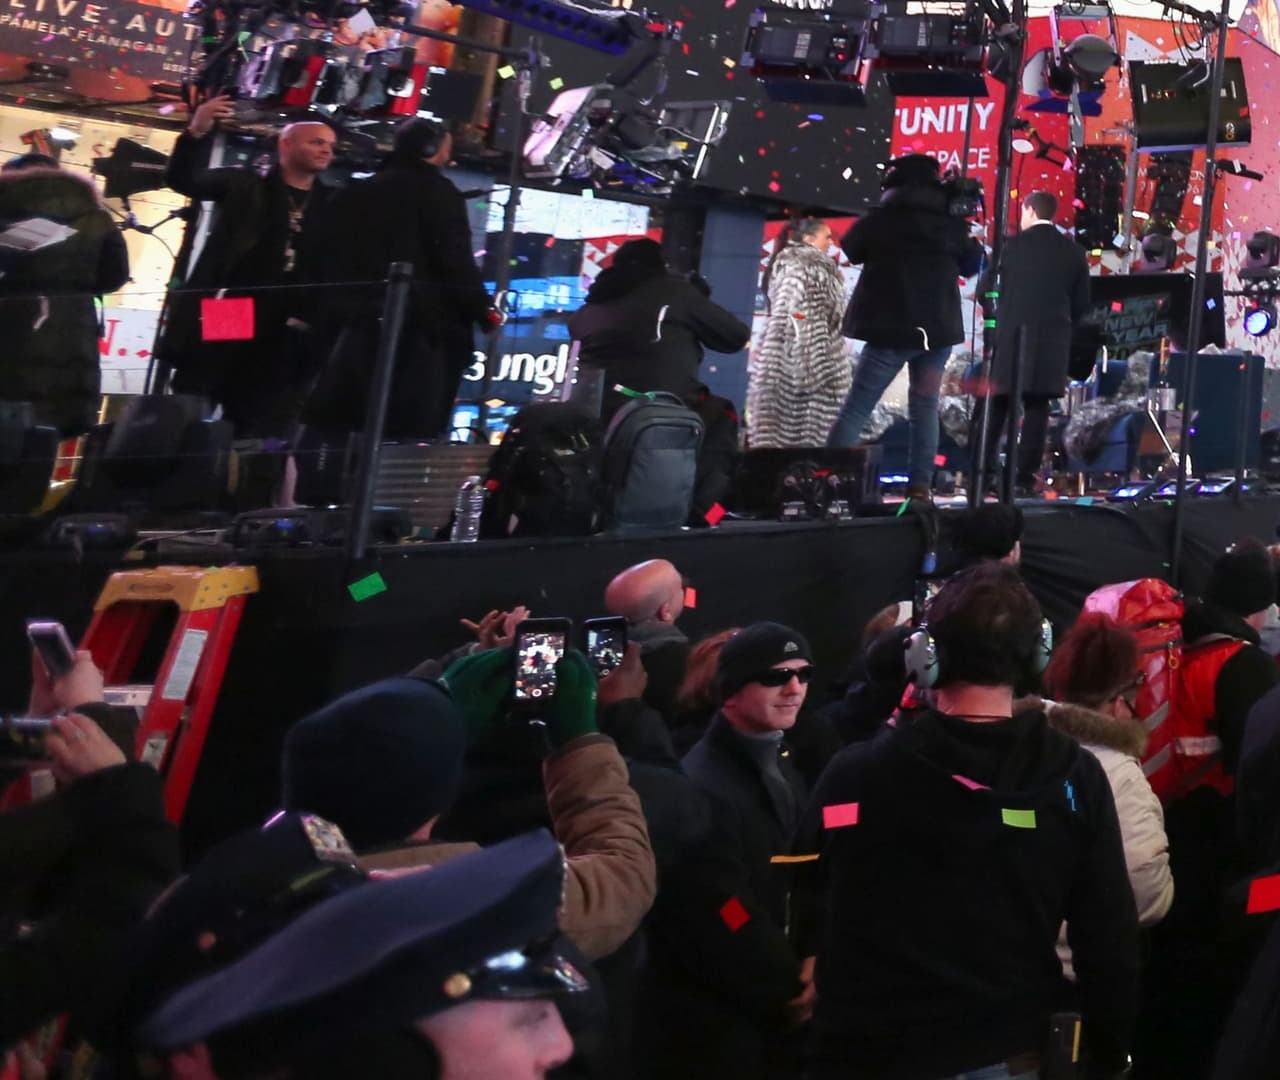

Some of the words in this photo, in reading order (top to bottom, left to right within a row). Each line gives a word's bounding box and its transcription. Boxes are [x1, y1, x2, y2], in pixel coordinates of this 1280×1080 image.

[0, 13, 71, 37] PAMELA
[895, 102, 996, 136] UNITY
[1112, 324, 1168, 343] YEAR
